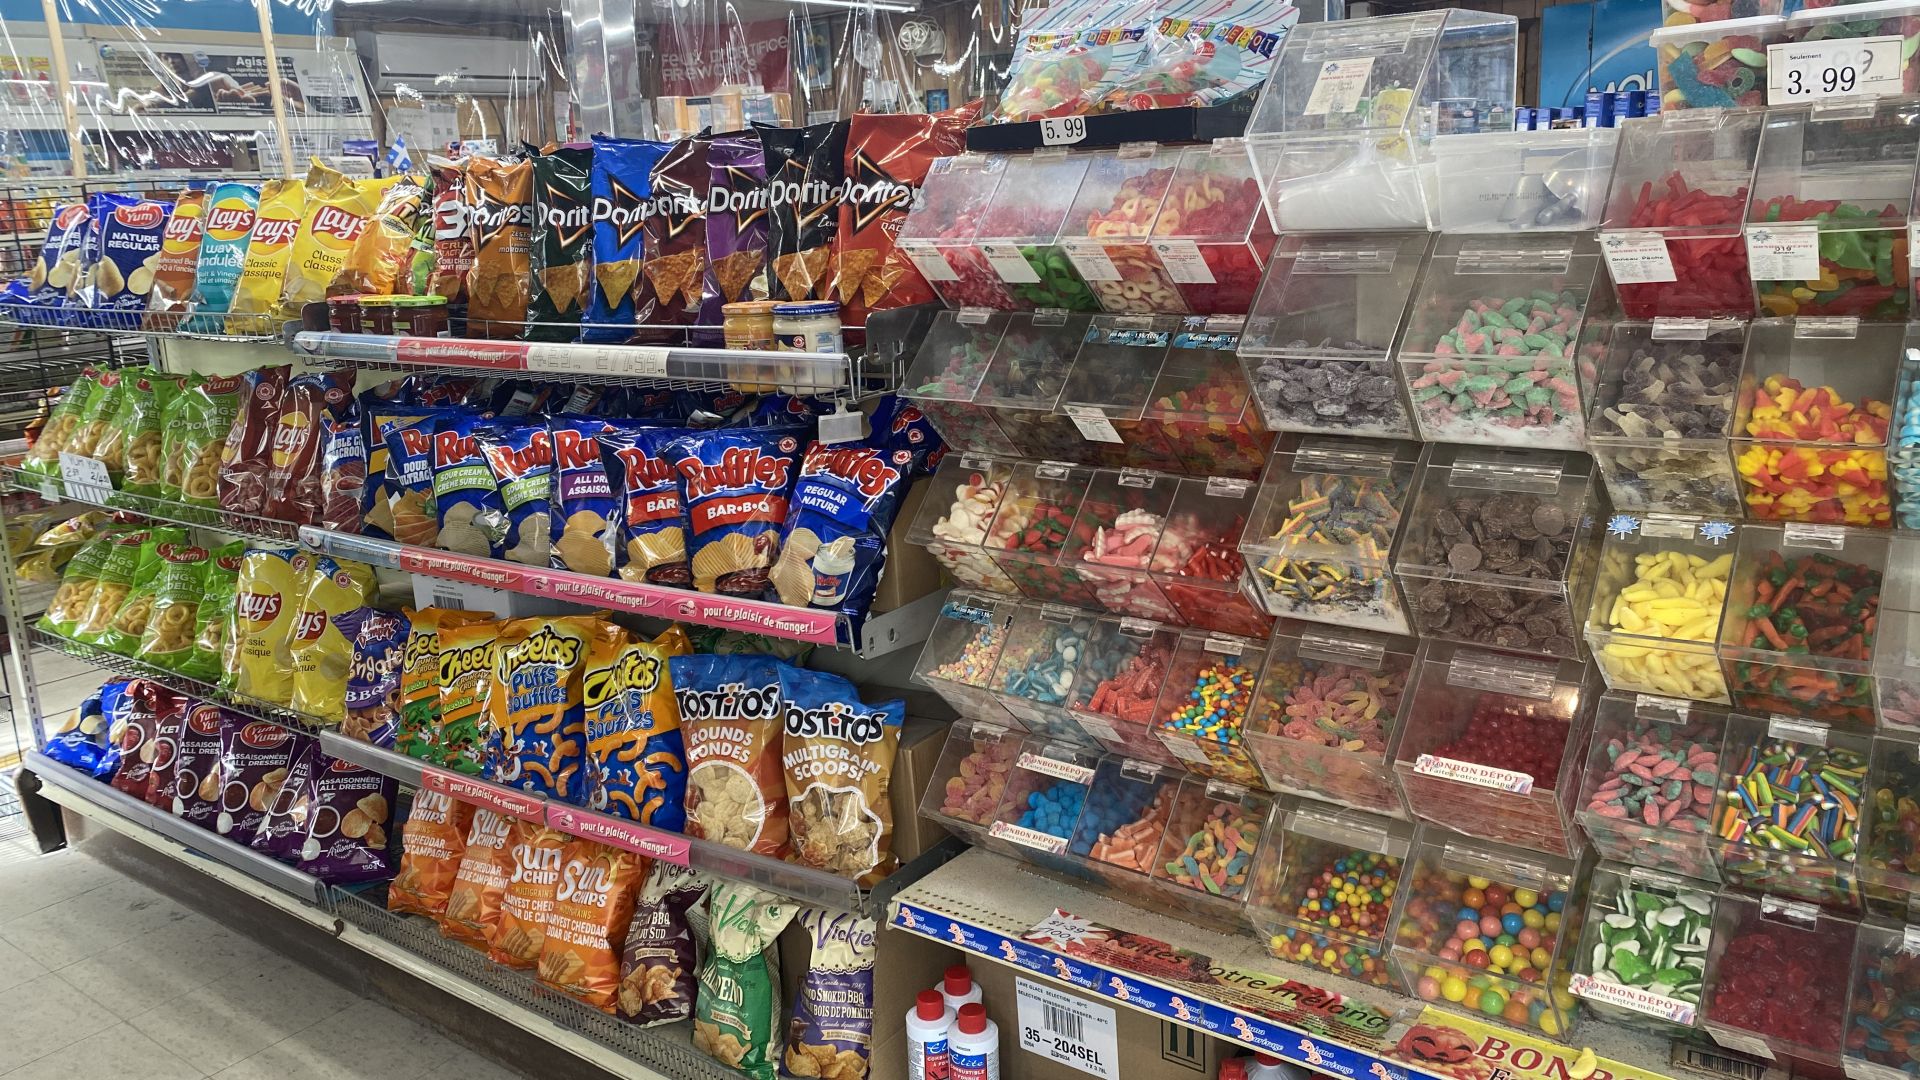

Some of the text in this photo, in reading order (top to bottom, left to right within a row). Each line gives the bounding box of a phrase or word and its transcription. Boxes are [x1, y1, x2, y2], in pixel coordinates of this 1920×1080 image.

[1787, 66, 1856, 94] 3.99
[1045, 118, 1084, 142] 5.99
[709, 186, 768, 212] Dorit
[127, 210, 153, 222] Yum
[537, 201, 590, 227] Dorit
[594, 197, 647, 224] Dorit
[207, 208, 256, 231] Lay's
[112, 232, 159, 243] NATURE
[250, 217, 300, 245] Lay's
[108, 241, 160, 251] REGULAR
[312, 250, 344, 264] Classi
[244, 269, 281, 279] assique
[440, 469, 482, 482] SOUR CREAM
[459, 478, 477, 486] SURE
[478, 477, 487, 486] ET
[574, 476, 592, 484] ALL
[676, 446, 793, 502] Ruffles
[506, 482, 525, 496] SOUR
[568, 486, 611, 496] ASSAISON
[804, 485, 848, 507] REGULAR
[801, 495, 840, 515] NATURE
[428, 559, 443, 570] pour
[443, 559, 450, 568] le
[450, 560, 471, 575] plaisir
[472, 566, 480, 576] de
[555, 582, 571, 594] pour
[572, 583, 580, 593] le
[580, 585, 604, 601] plaisir
[605, 591, 615, 601] de
[703, 606, 723, 621] pour
[724, 606, 733, 618] le
[733, 609, 762, 625] plaisir
[763, 614, 774, 627] de
[440, 640, 493, 687] Cheet
[512, 665, 557, 693] Puffs
[346, 686, 384, 702] BBQ
[251, 725, 276, 735] Yum
[690, 727, 754, 747] ROUNDS
[689, 743, 751, 764] RONDES
[784, 745, 881, 775] MULTIGRAIN
[794, 762, 864, 782] SCOOPS!
[319, 777, 380, 785] ASSAISONNÉES
[339, 783, 379, 791] DRESSED
[450, 782, 465, 793] pour
[465, 783, 472, 793] le
[472, 785, 493, 801] plaisir
[493, 794, 501, 805] de
[414, 809, 447, 825] CHIPS
[477, 834, 505, 849] CHIPS
[580, 821, 596, 833] pour
[596, 822, 604, 833] le
[605, 825, 630, 842] plaisir
[630, 833, 640, 845] de
[410, 835, 446, 849] CHEDDAR
[474, 861, 502, 876] CHEDDAR
[511, 844, 562, 883] Sun
[523, 871, 559, 885] CHIP
[557, 852, 617, 901] Sun
[532, 899, 554, 911] CHED
[572, 891, 608, 908] CHIPS
[524, 911, 533, 922] DE
[652, 912, 671, 925] BBQ
[571, 919, 607, 937] CHEDDAR
[564, 931, 611, 950] DE CAMPAGN
[817, 988, 865, 1005] SMOKED BBQ
[1030, 985, 1043, 993] GLACE
[1046, 991, 1070, 1002] SELECTION
[1581, 980, 1635, 999] BONBON
[814, 1006, 830, 1017] BOIS
[831, 1007, 840, 1018] DE
[1018, 989, 1041, 1001] SELECTION
[1072, 1009, 1092, 1019] WASHER
